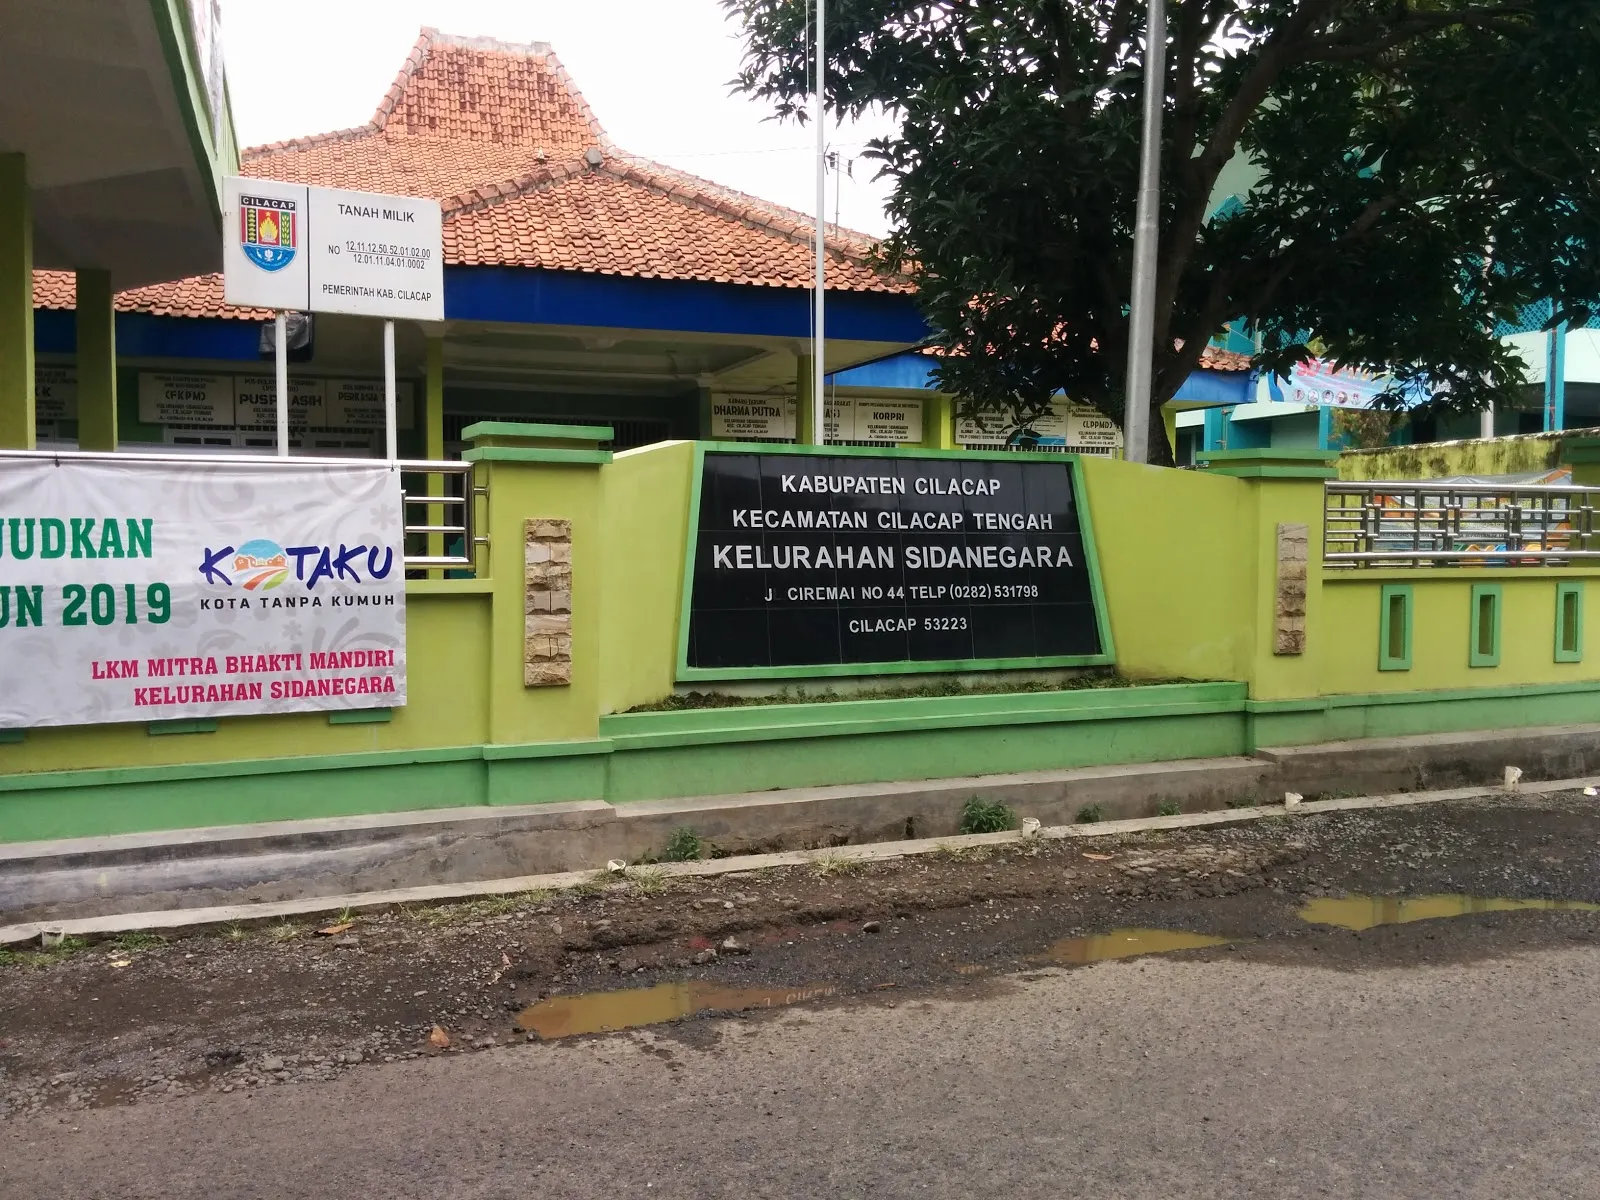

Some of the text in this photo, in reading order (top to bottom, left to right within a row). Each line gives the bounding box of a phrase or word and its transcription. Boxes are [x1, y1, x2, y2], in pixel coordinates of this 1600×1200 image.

[242, 197, 295, 209] CILACAP
[338, 204, 415, 223] TANAH MILIK
[328, 241, 431, 258] NO 12.11.12.50.52.01.02.00
[353, 254, 425, 270] 12.01.11.04.01.0002
[322, 284, 432, 302] PEMERINTAH KAB. CILACAP
[165, 390, 206, 401] (FKPM)
[291, 395, 322, 406] ASIH
[713, 405, 781, 417] DHARMA PUTRA
[873, 411, 905, 421] KORPRI
[781, 474, 1002, 497] KABUPATEN CILACAP
[732, 508, 1053, 531] KECAMATAN CILACAP TENGAH
[0, 517, 153, 561] UDKAN
[713, 544, 1074, 570] KELURAHAN SIDANEGARA
[787, 585, 855, 601] CIREMAI
[861, 585, 883, 601] NO
[886, 585, 905, 600] 44
[909, 585, 947, 600] TELP
[949, 584, 992, 601] (0282)
[994, 584, 1039, 599] 531798
[62, 582, 172, 627] 2019
[200, 594, 395, 611] KOTA TANPA KUMUH
[849, 617, 968, 634] CILACAP 53223
[91, 649, 395, 680] LKM MITRA BHAKTI MANDIRI
[133, 675, 396, 707] KELURAHAN SIDANEGARA
